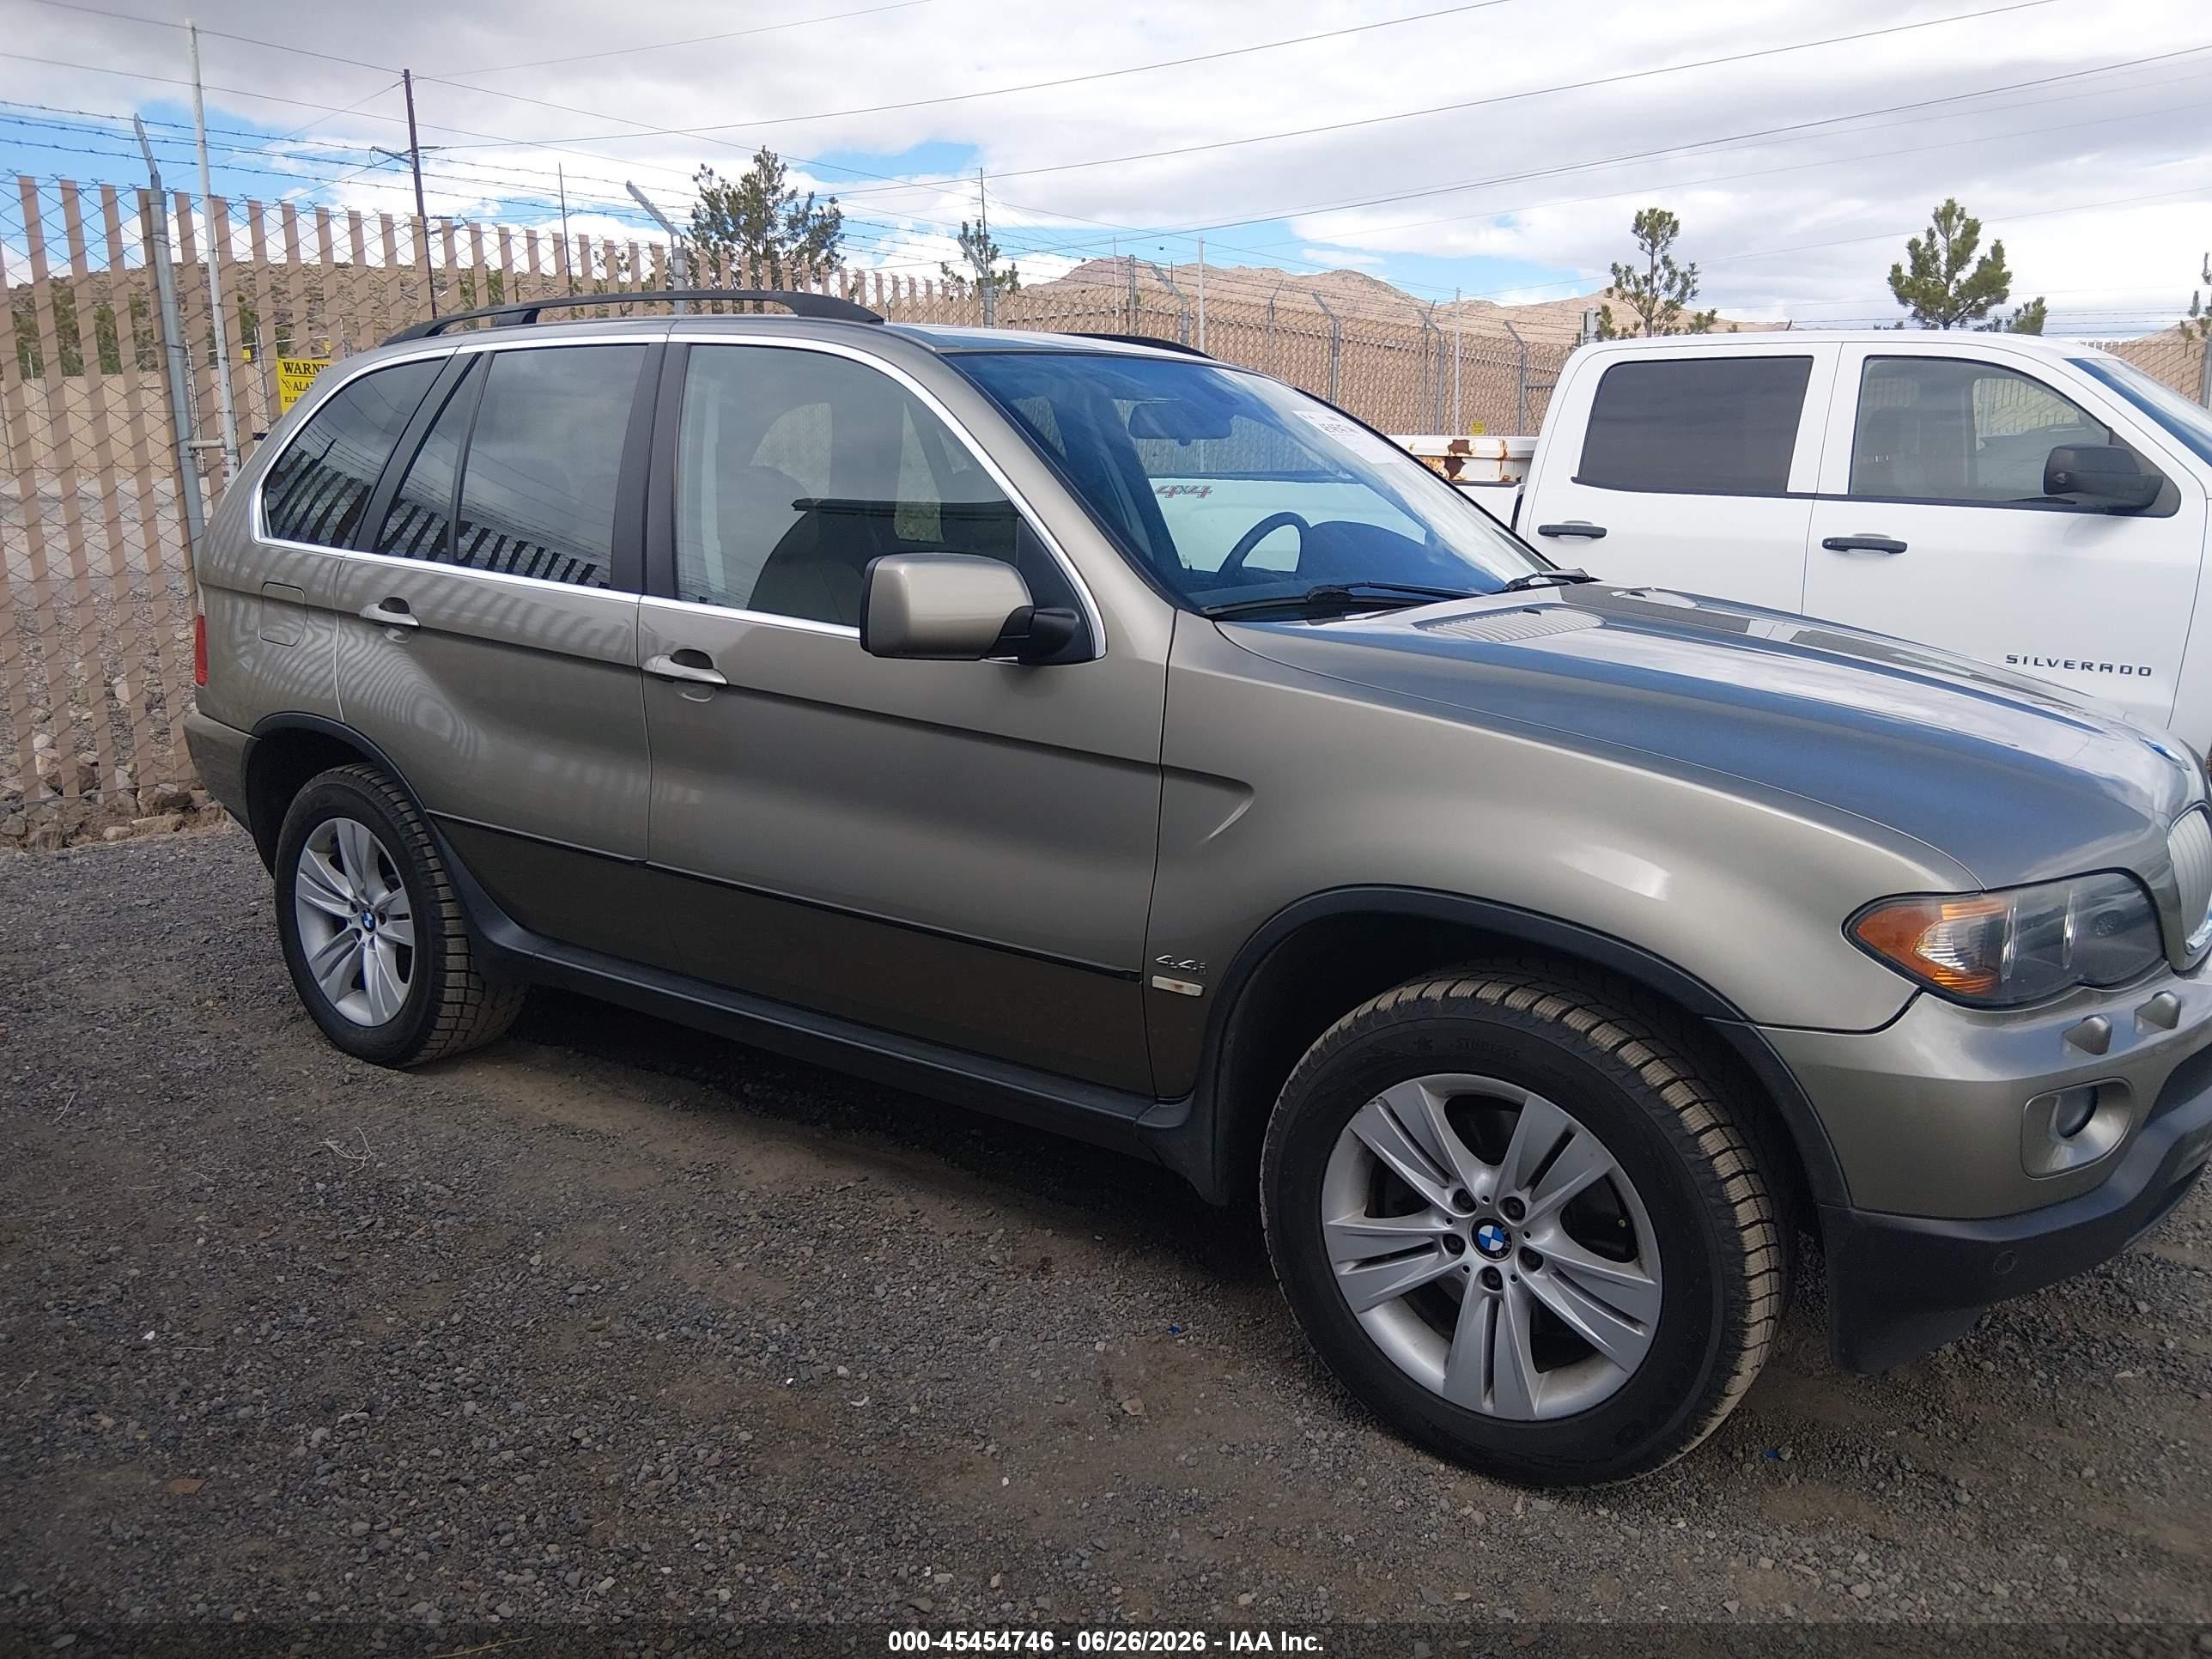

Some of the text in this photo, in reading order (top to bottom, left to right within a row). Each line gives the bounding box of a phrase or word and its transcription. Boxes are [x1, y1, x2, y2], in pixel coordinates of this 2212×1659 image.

[283, 362, 329, 375] WARN
[293, 381, 313, 392] ALA
[2005, 653, 2153, 677] SILVERADO
